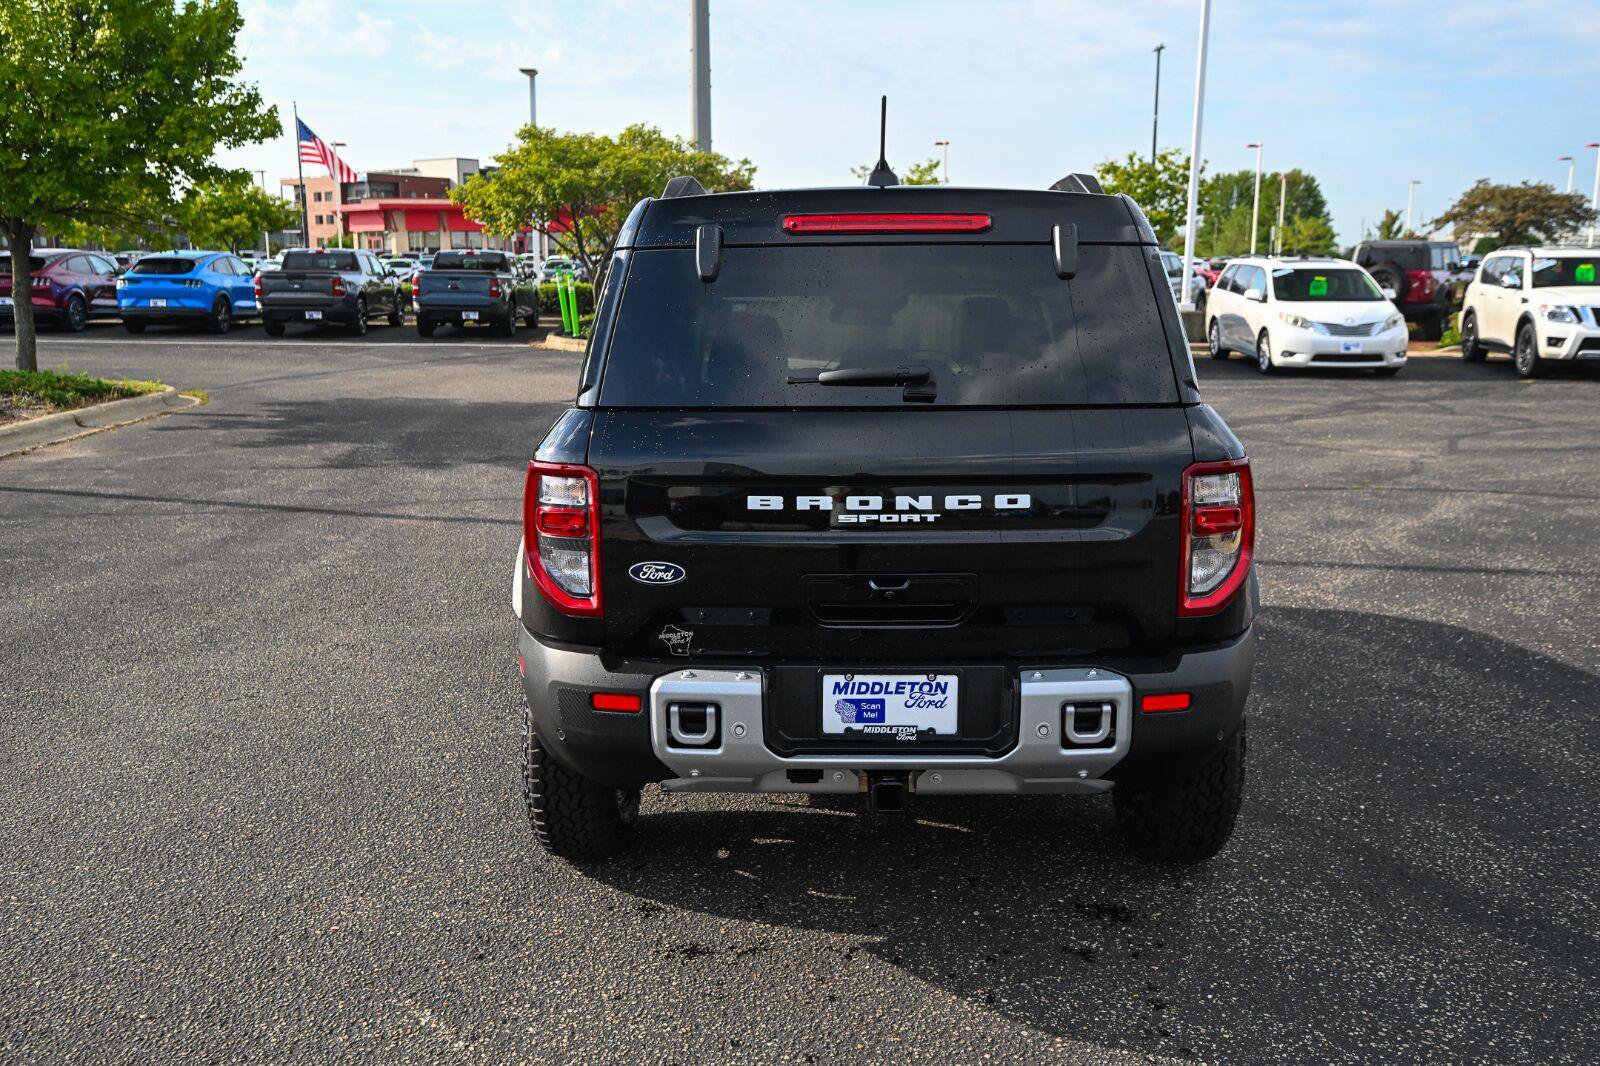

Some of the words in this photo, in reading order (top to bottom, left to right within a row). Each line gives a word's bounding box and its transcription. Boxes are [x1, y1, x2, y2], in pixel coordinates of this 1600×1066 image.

[747, 494, 1031, 510] BRONCO
[837, 514, 941, 522] SPORT
[639, 565, 675, 580] Ford
[658, 631, 694, 640] MIDDLETON
[670, 637, 686, 645] Ford
[833, 681, 949, 695] MIDDLETON
[905, 691, 948, 709] Ford
[861, 702, 881, 710] Scan
[863, 726, 917, 734] MIDDLETON
[896, 733, 917, 741] Ford
